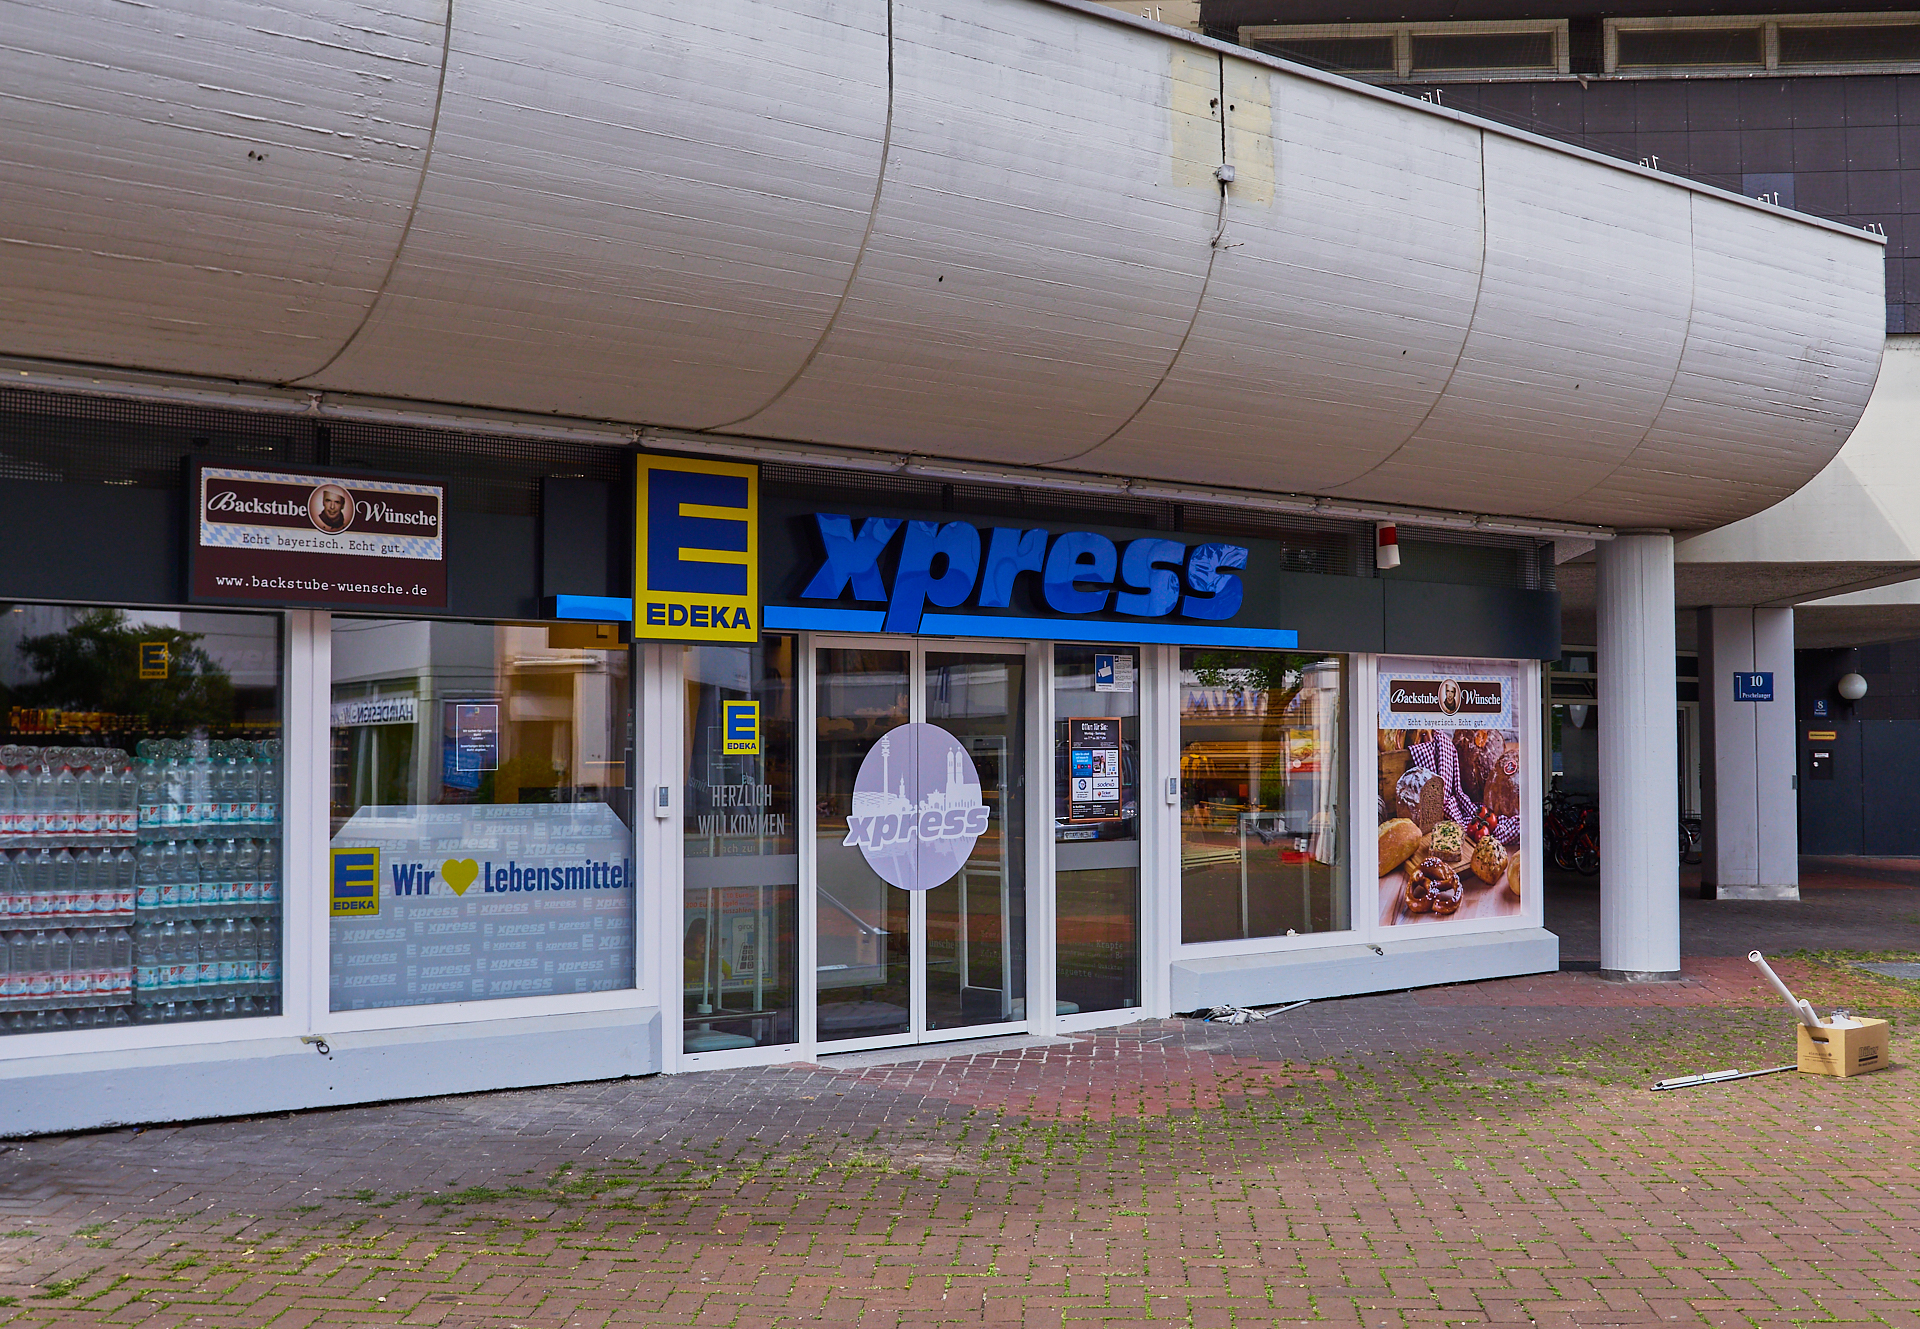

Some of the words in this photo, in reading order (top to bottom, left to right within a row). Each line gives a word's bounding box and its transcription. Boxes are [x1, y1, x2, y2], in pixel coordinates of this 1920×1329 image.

[207, 491, 307, 517] Backstube
[355, 501, 437, 526] Wünsche
[242, 533, 270, 545] Echt
[277, 535, 344, 550] bayerisch.
[349, 540, 375, 552] Echt
[381, 543, 406, 555] gut.
[801, 512, 1249, 633] xpress
[215, 575, 428, 596] www.backstube-wuensche.de
[646, 603, 752, 629] EDEKA
[1750, 675, 1763, 687] 10
[1391, 688, 1439, 704] Backstube
[1461, 690, 1501, 705] Wünsche
[1817, 701, 1824, 709] 8
[1424, 719, 1457, 728] bayerisch.
[712, 784, 772, 807] HERZLICH
[485, 807, 533, 818] xpress
[551, 804, 598, 815] xpress
[485, 825, 527, 834] xpress
[550, 824, 612, 837] xpress
[698, 813, 785, 837] WILLKOMMEN
[845, 807, 989, 848] xpress
[436, 838, 499, 851] xpress
[524, 843, 585, 856] xpress
[392, 863, 435, 896] Wir
[333, 901, 375, 911] EDEKA
[480, 903, 529, 914] xpress
[544, 900, 577, 909] xpress
[408, 907, 459, 918] xpress
[427, 922, 477, 933] xpress
[497, 924, 545, 935] xpress
[558, 921, 591, 930] xpress
[342, 928, 406, 942] xpress
[420, 944, 471, 956] xpress
[347, 954, 398, 965] xpress
[490, 958, 538, 969] xpress
[421, 965, 471, 977] xpress
[557, 960, 604, 972] xpress
[344, 974, 397, 986] xpress
[489, 978, 553, 993] xpress
[420, 981, 464, 992] xpress
